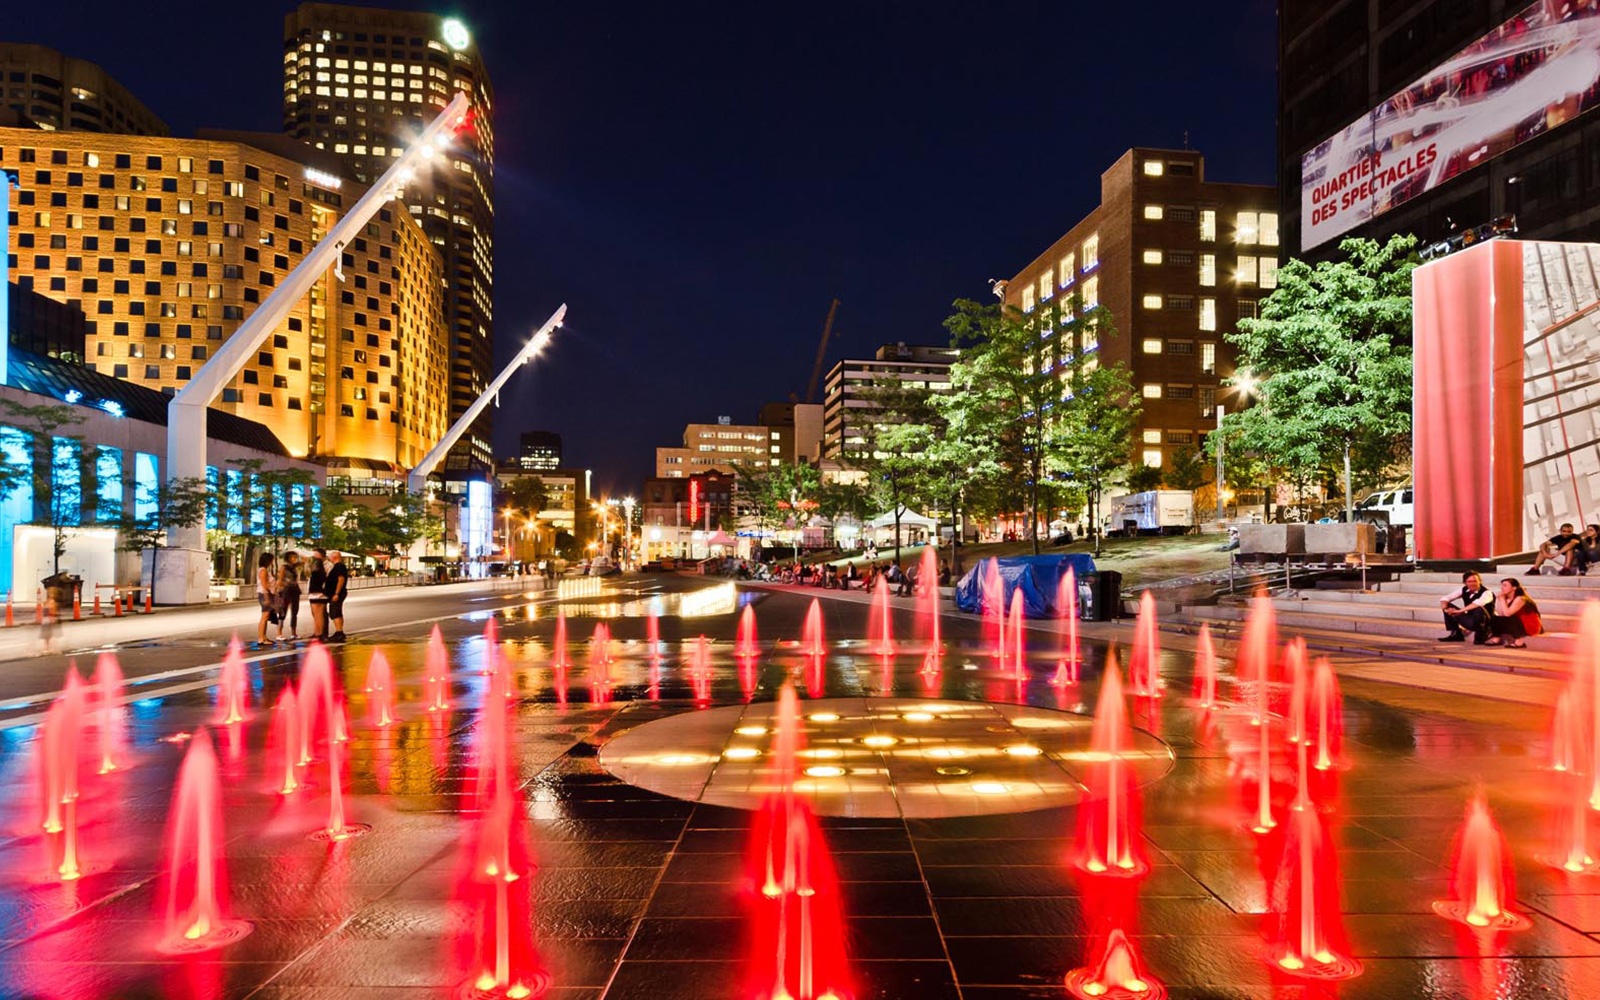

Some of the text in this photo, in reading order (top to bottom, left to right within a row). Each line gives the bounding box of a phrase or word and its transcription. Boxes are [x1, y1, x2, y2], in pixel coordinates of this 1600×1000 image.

[1312, 151, 1381, 204] QUARTIER
[1312, 143, 1437, 226] DES SPECTACLES
